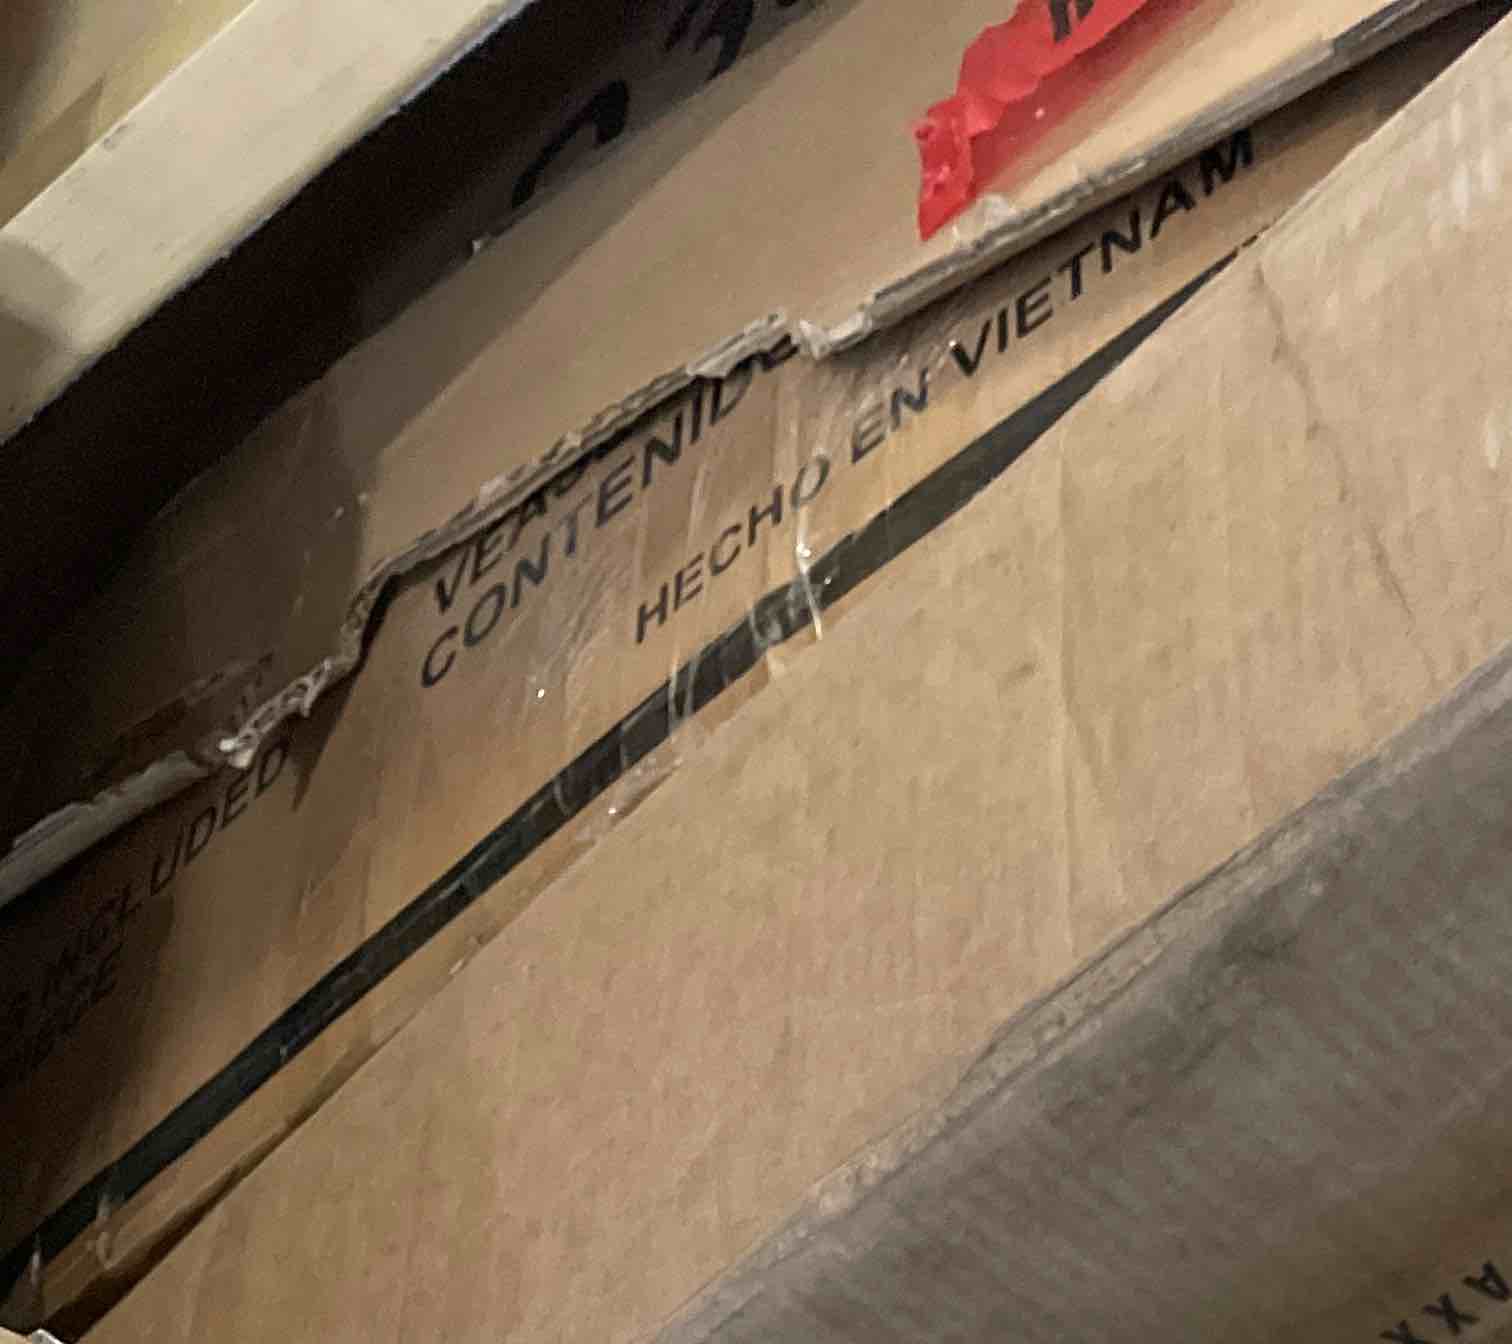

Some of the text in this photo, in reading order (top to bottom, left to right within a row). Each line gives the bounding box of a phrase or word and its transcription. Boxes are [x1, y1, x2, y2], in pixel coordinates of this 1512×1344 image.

[635, 127, 1255, 645] HECHO EN VIETNAM
